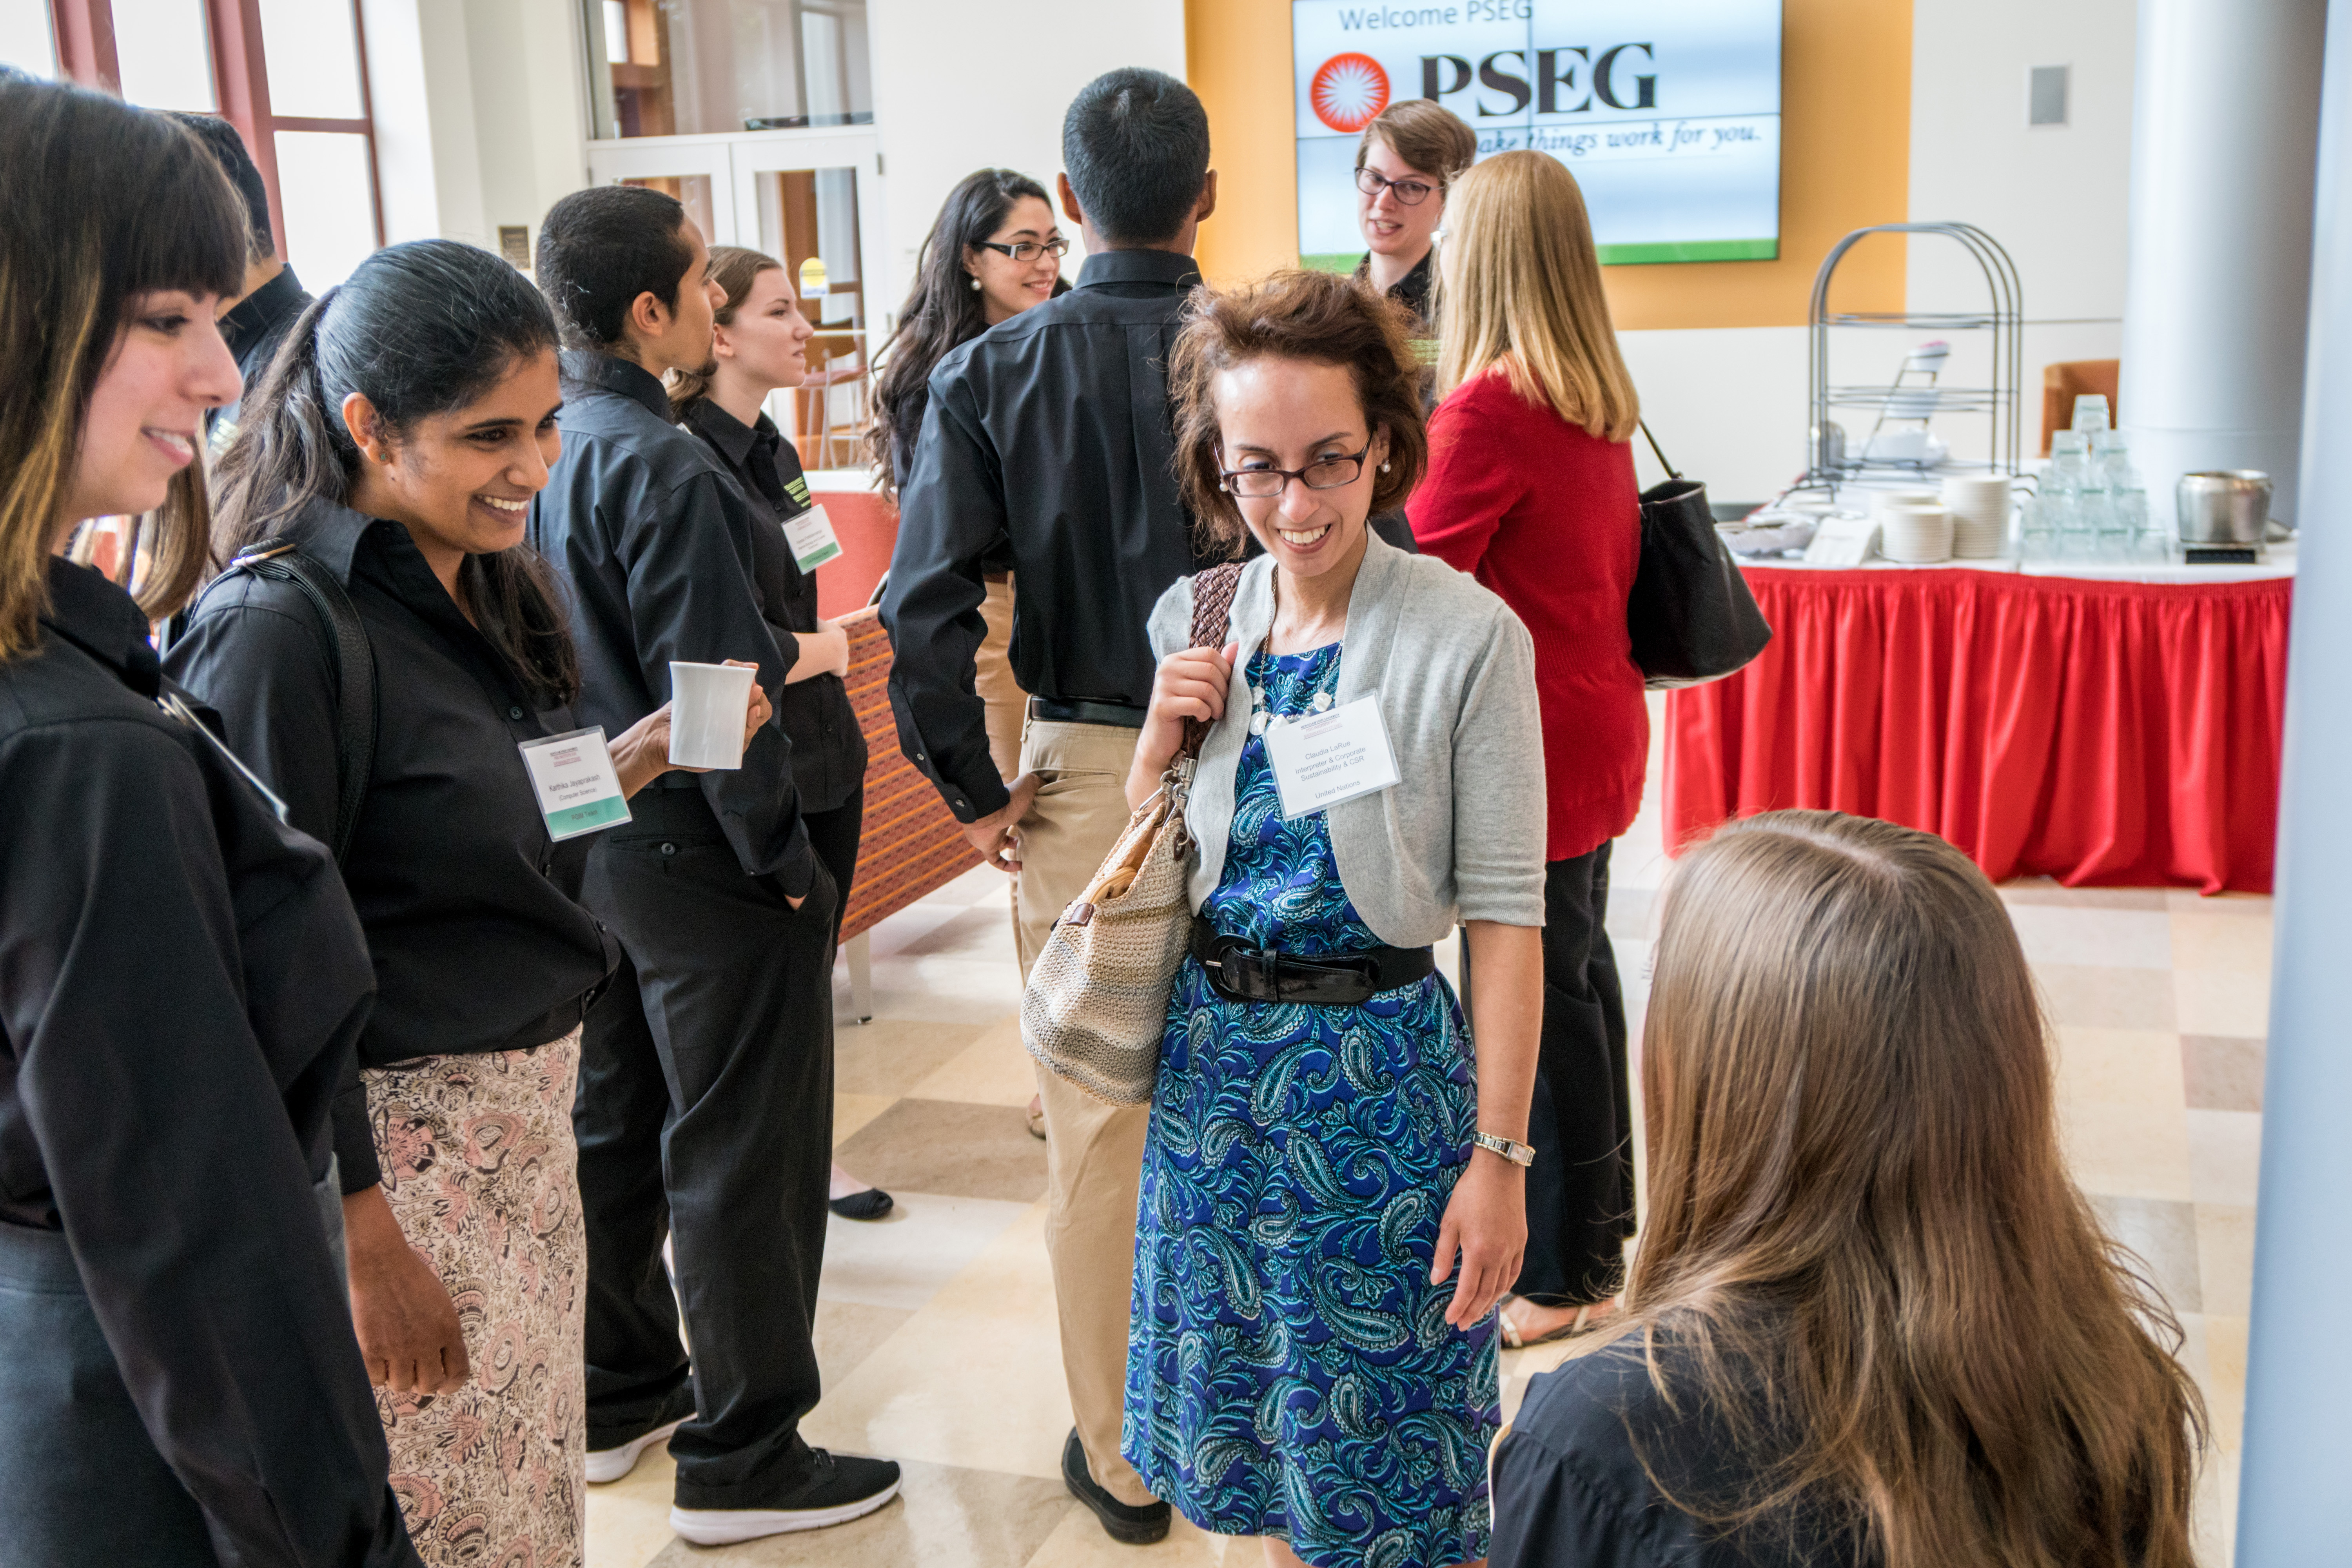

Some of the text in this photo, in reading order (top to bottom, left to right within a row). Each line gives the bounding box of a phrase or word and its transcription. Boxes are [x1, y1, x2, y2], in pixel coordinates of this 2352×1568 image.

[1339, 0, 1532, 31] Welcome PSEG
[1419, 42, 1658, 116] PSEG
[1479, 120, 1761, 156] ake things work for you.
[1295, 760, 1327, 774] Interpreter
[1335, 747, 1366, 761] Corporate
[1305, 741, 1351, 760] Claudia LaRue
[1301, 764, 1341, 781] Sustainability
[1349, 755, 1365, 765] CSR
[549, 774, 601, 792] Karthika Jayaprakash
[1315, 780, 1361, 799] United Nations
